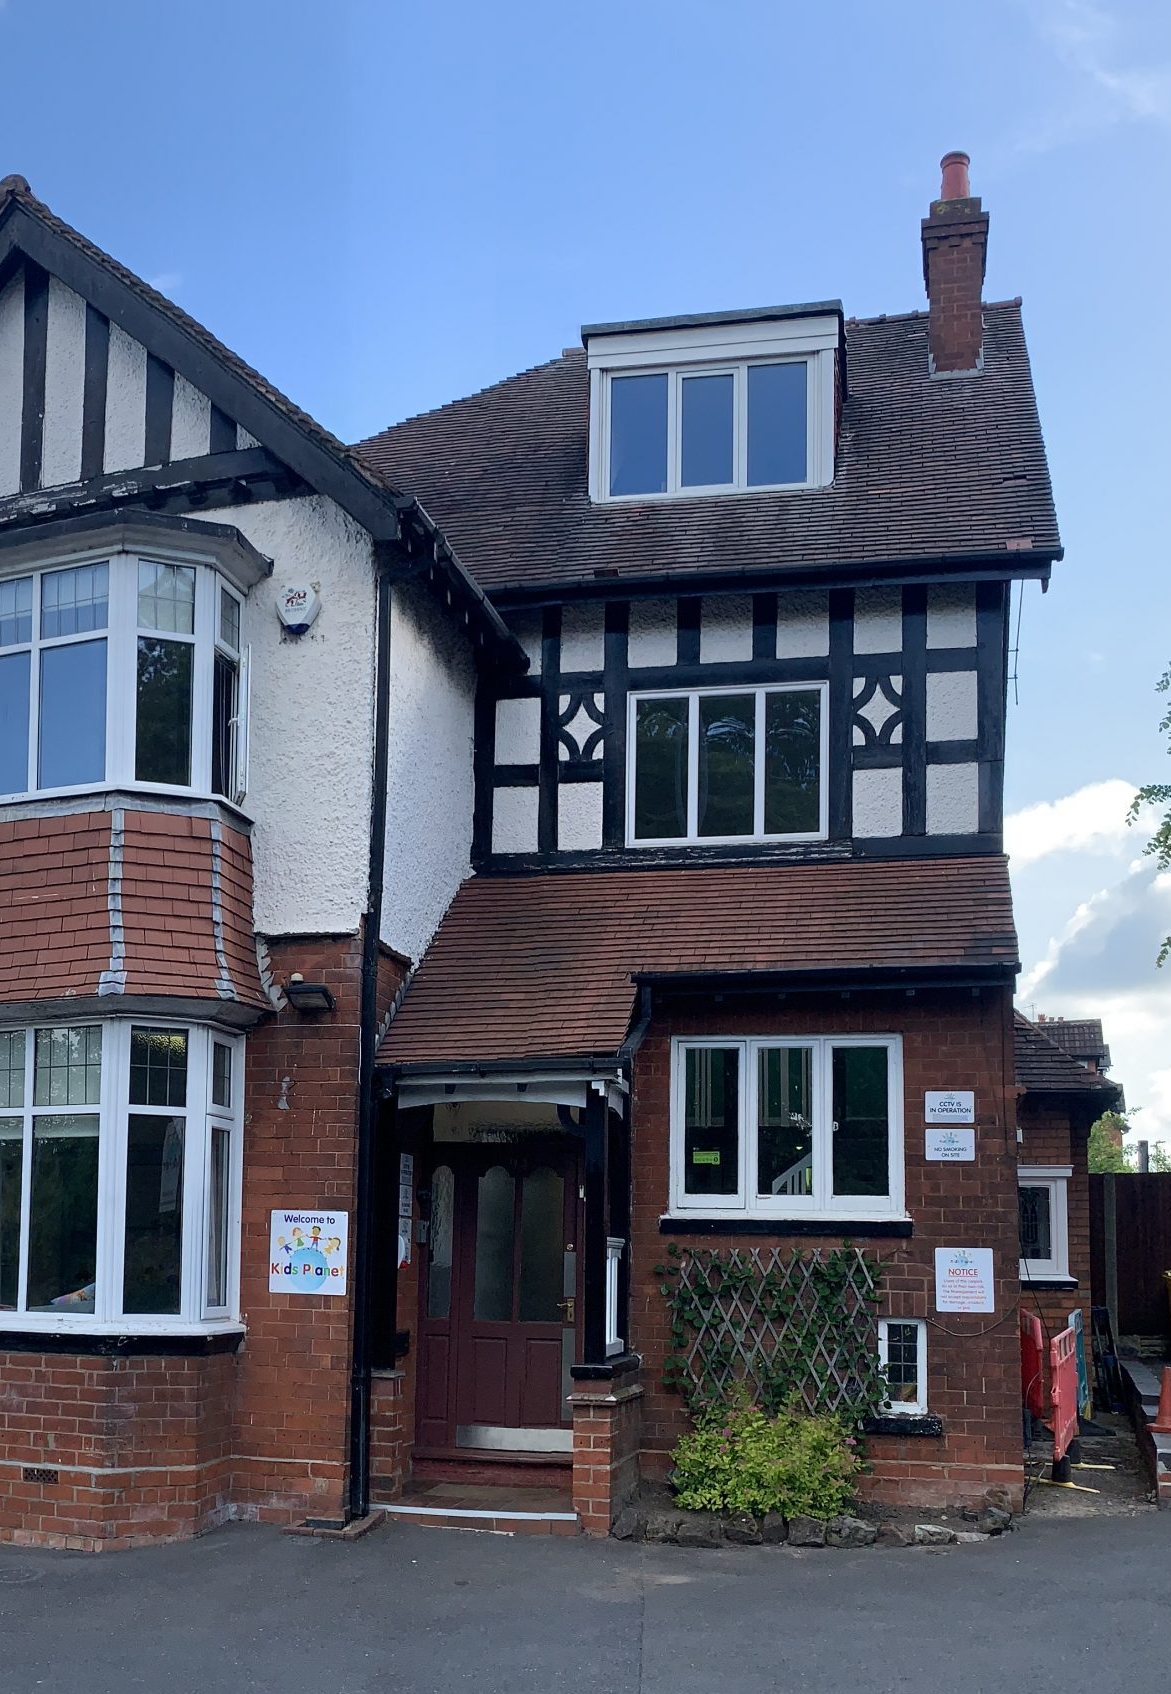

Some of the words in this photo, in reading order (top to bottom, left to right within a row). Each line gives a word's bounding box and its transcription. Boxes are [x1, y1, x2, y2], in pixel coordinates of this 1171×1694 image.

[284, 1214, 324, 1224] Welcome
[326, 1216, 335, 1224] to
[271, 1262, 298, 1275] Kids
[303, 1264, 344, 1277] Planet
